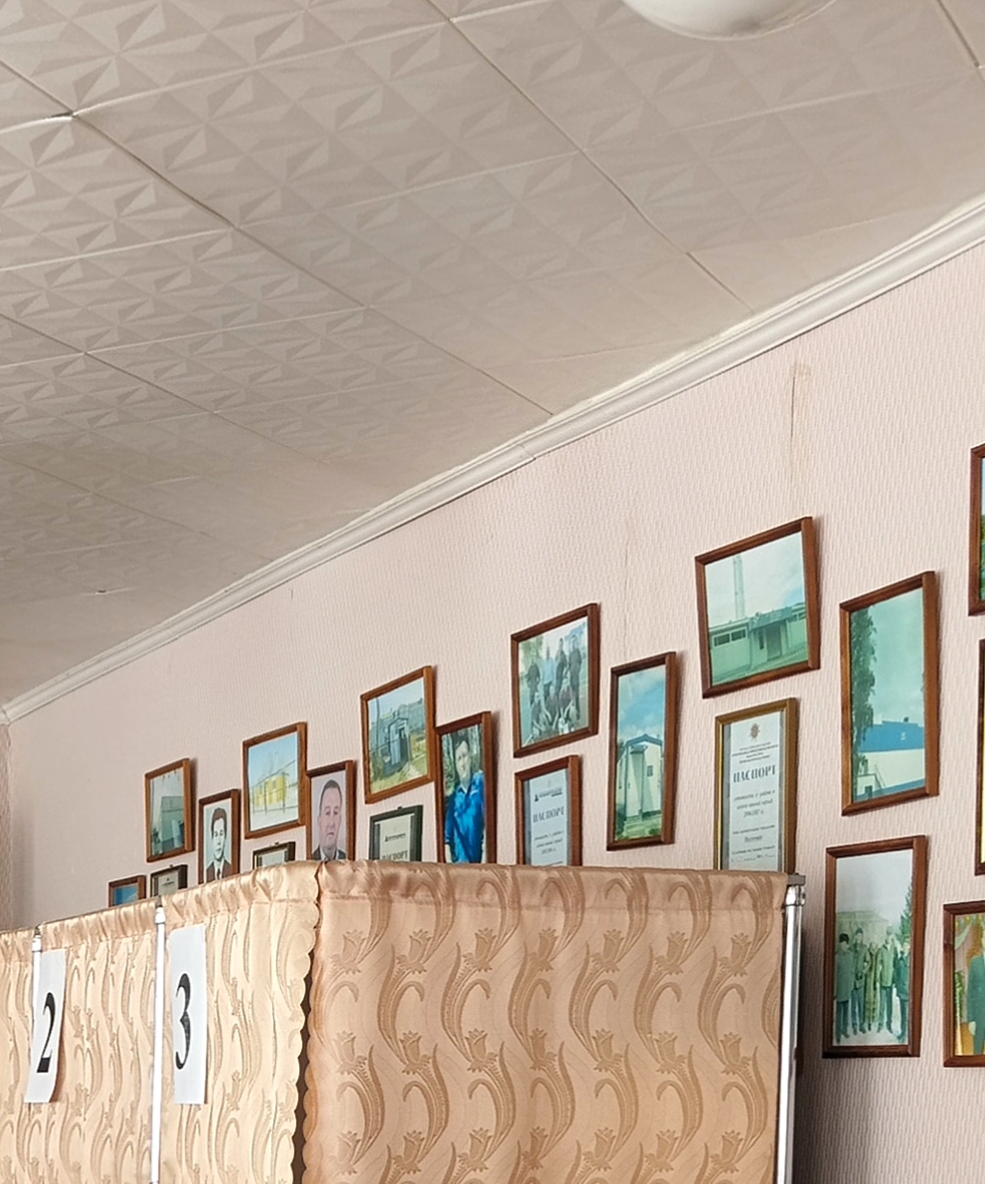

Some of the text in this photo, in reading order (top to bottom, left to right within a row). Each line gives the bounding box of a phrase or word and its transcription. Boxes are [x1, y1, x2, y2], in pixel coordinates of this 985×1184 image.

[733, 764, 776, 783] ПАСПОРТ
[36, 992, 56, 1074] 2
[175, 972, 191, 1070] 3
